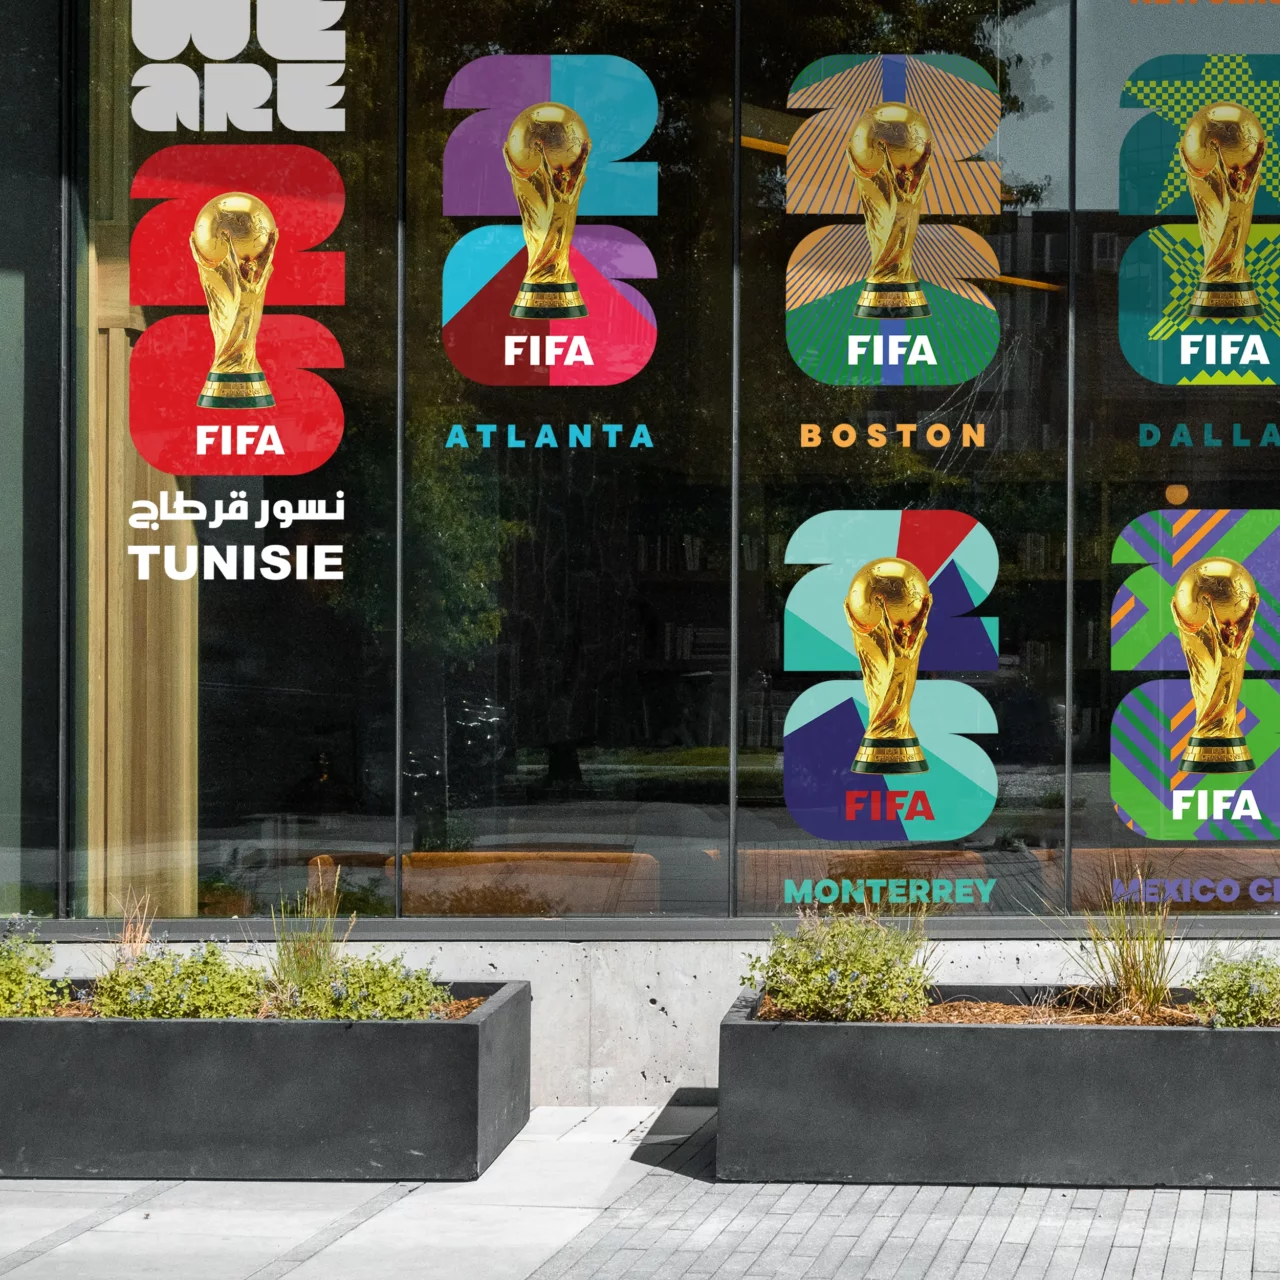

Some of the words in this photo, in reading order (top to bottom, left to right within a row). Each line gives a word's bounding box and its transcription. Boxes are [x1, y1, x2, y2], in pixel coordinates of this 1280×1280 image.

[504, 335, 594, 366] FIFA
[847, 334, 937, 365] FIFA
[1179, 334, 1270, 365] FIFA
[196, 425, 285, 456] FIFA
[445, 424, 655, 448] ATLANTA
[801, 423, 986, 448] BOSTON
[128, 490, 249, 531] قرطاج
[255, 490, 345, 529] نسور
[128, 544, 344, 581] TUNISIE
[845, 790, 935, 821] FIFA
[1172, 790, 1262, 820] FIFA
[784, 879, 997, 904] MONTERREY
[1112, 878, 1241, 903] MEXICO
